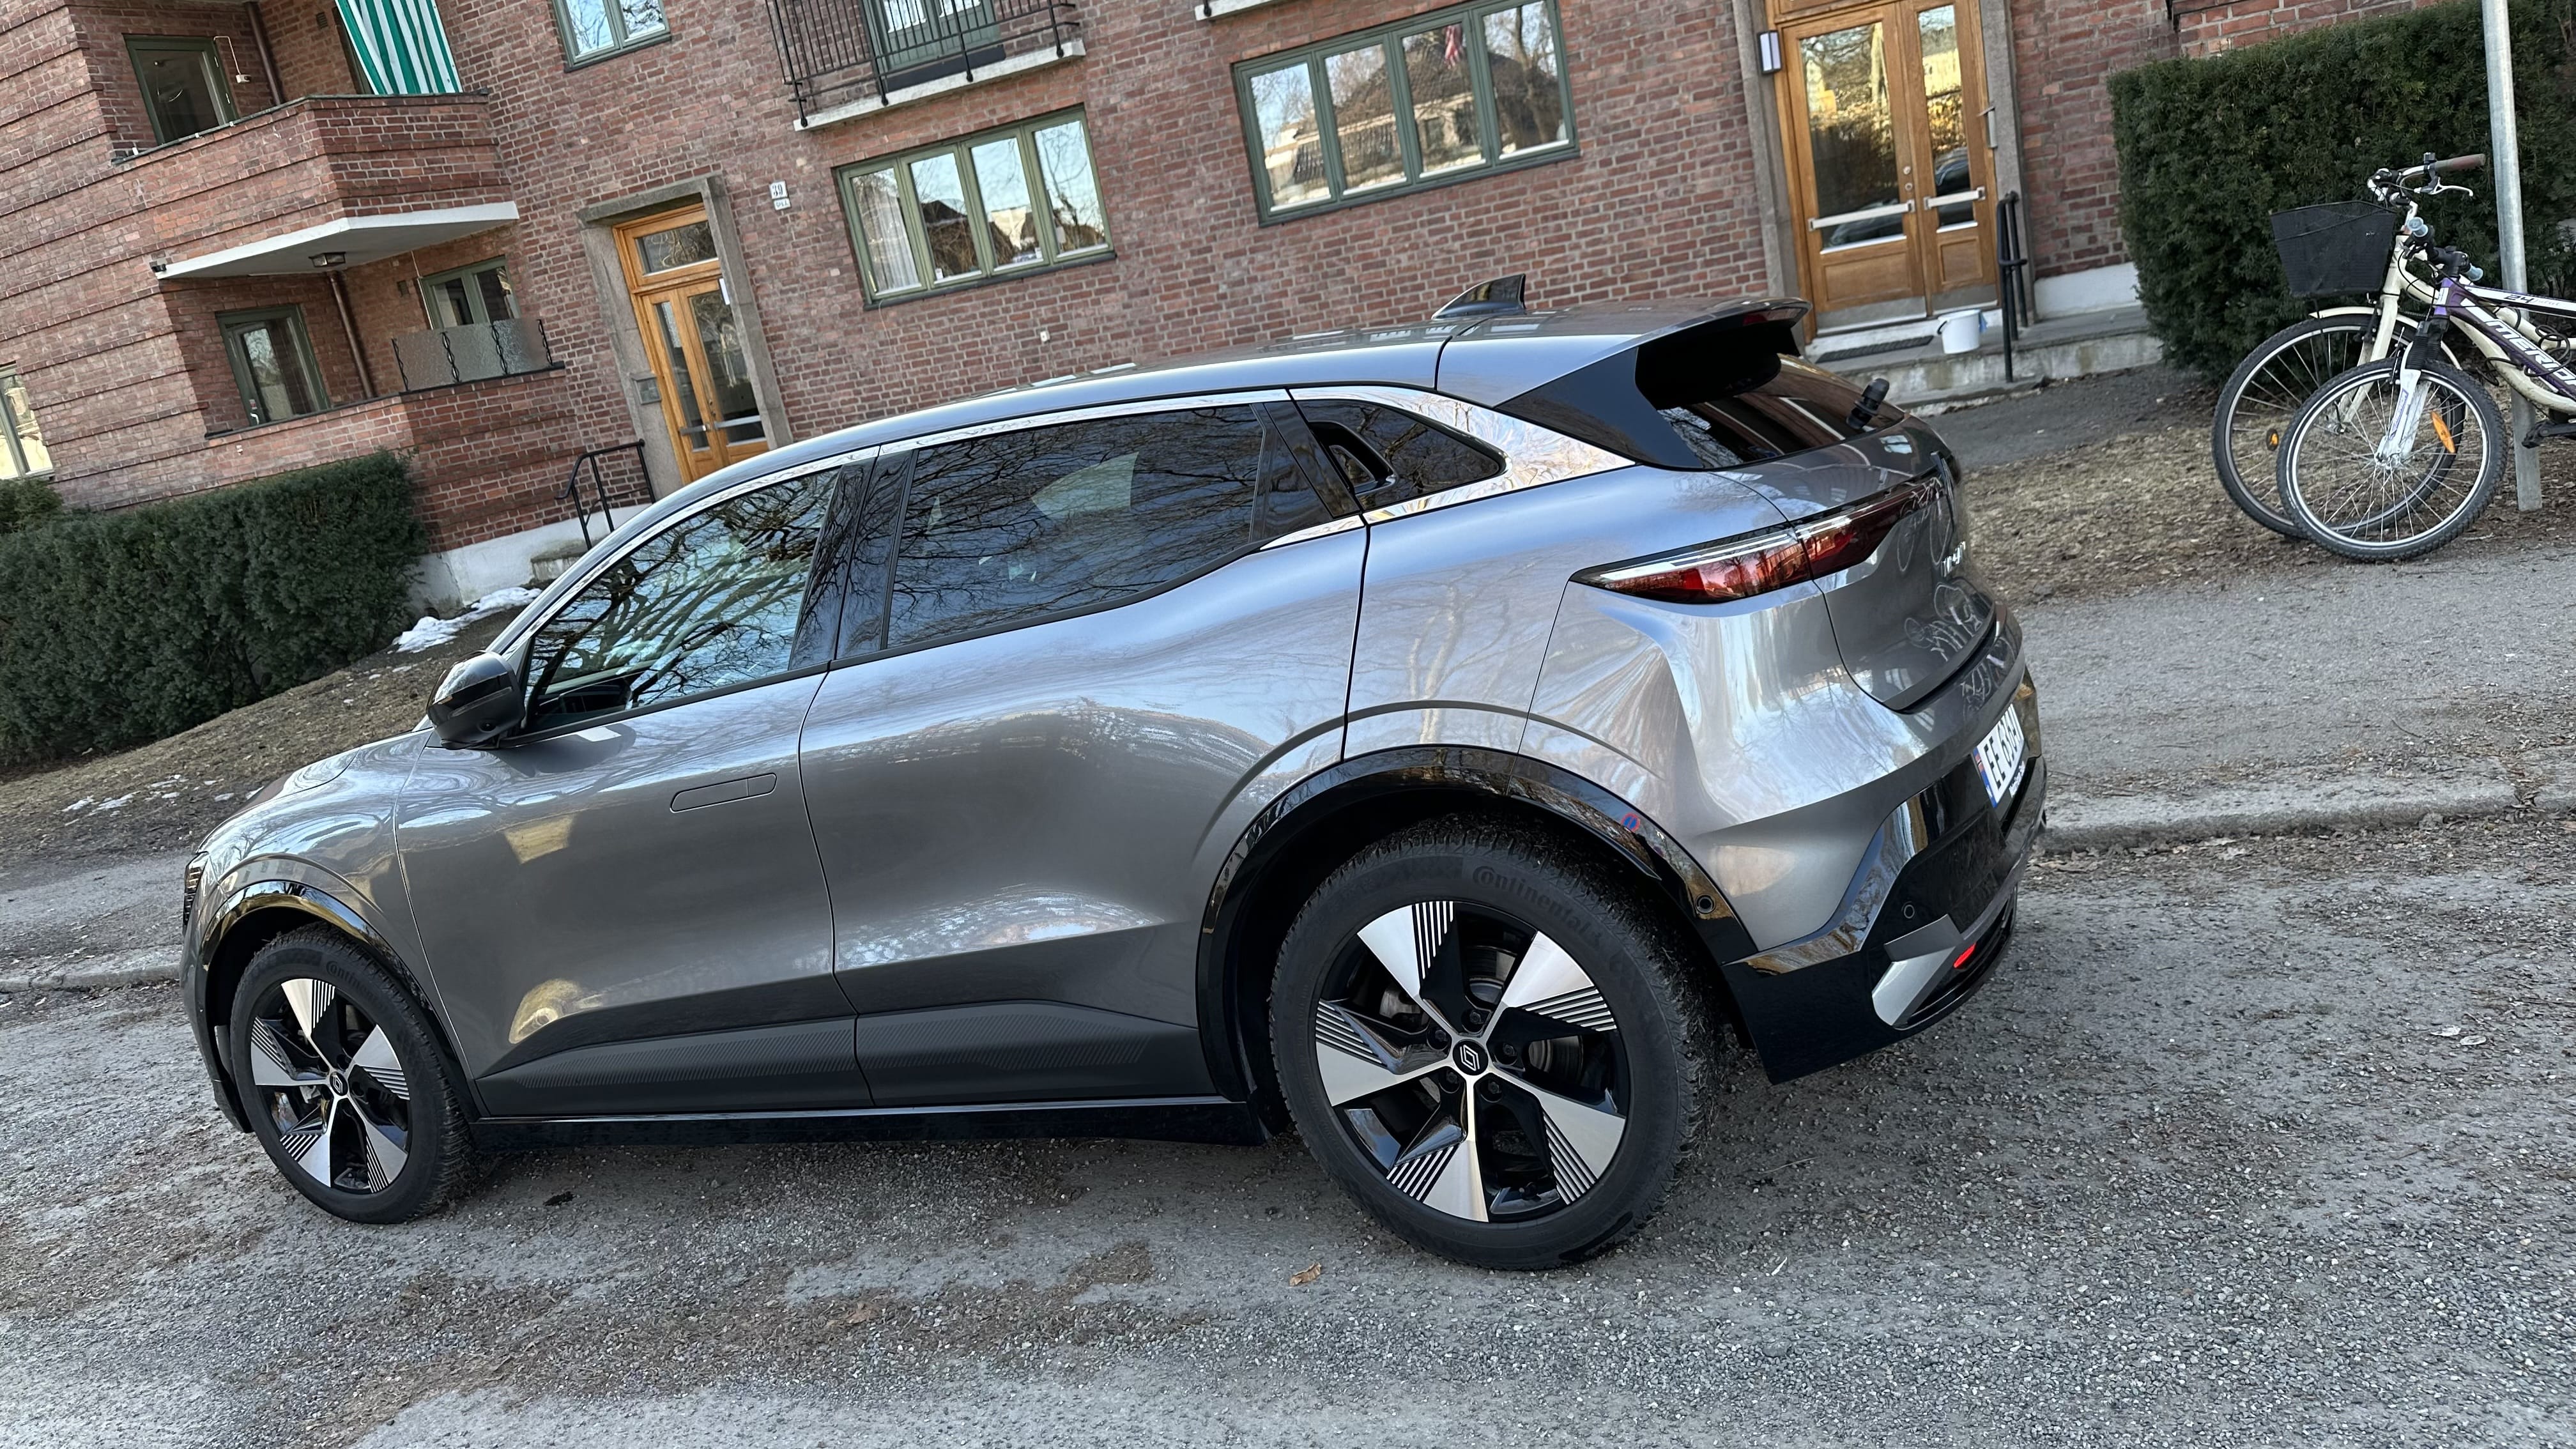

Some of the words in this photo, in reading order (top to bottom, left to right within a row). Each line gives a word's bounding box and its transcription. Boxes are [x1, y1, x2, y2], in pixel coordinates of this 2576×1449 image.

[772, 183, 783, 197] 39
[2504, 294, 2534, 303] 24
[1983, 735, 2007, 791] EE
[1472, 865, 1591, 938] Continental
